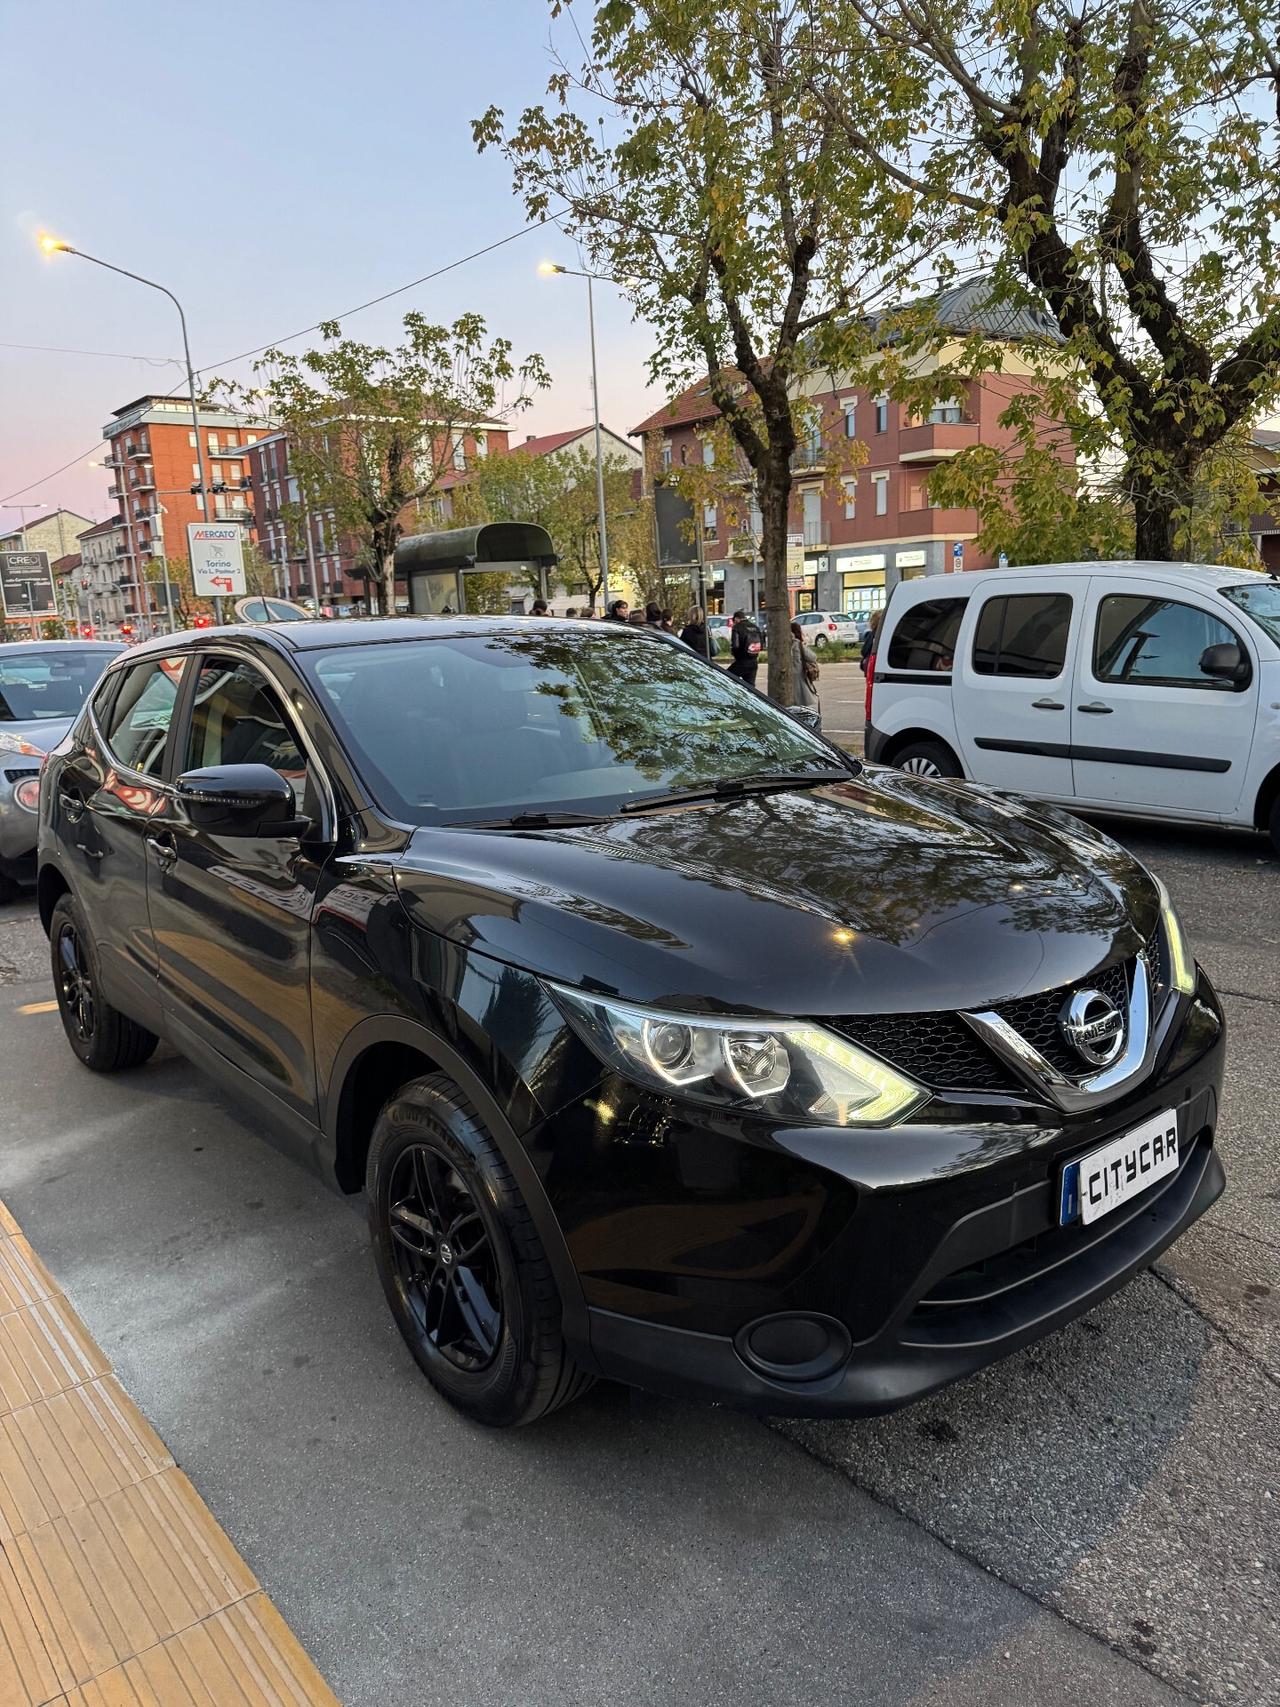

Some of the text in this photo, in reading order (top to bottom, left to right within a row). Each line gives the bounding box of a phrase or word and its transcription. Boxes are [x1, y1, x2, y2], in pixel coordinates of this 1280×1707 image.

[193, 530, 236, 540] MERCATO
[9, 556, 38, 565] CREO
[1088, 1126, 1177, 1205] CITYCAR
